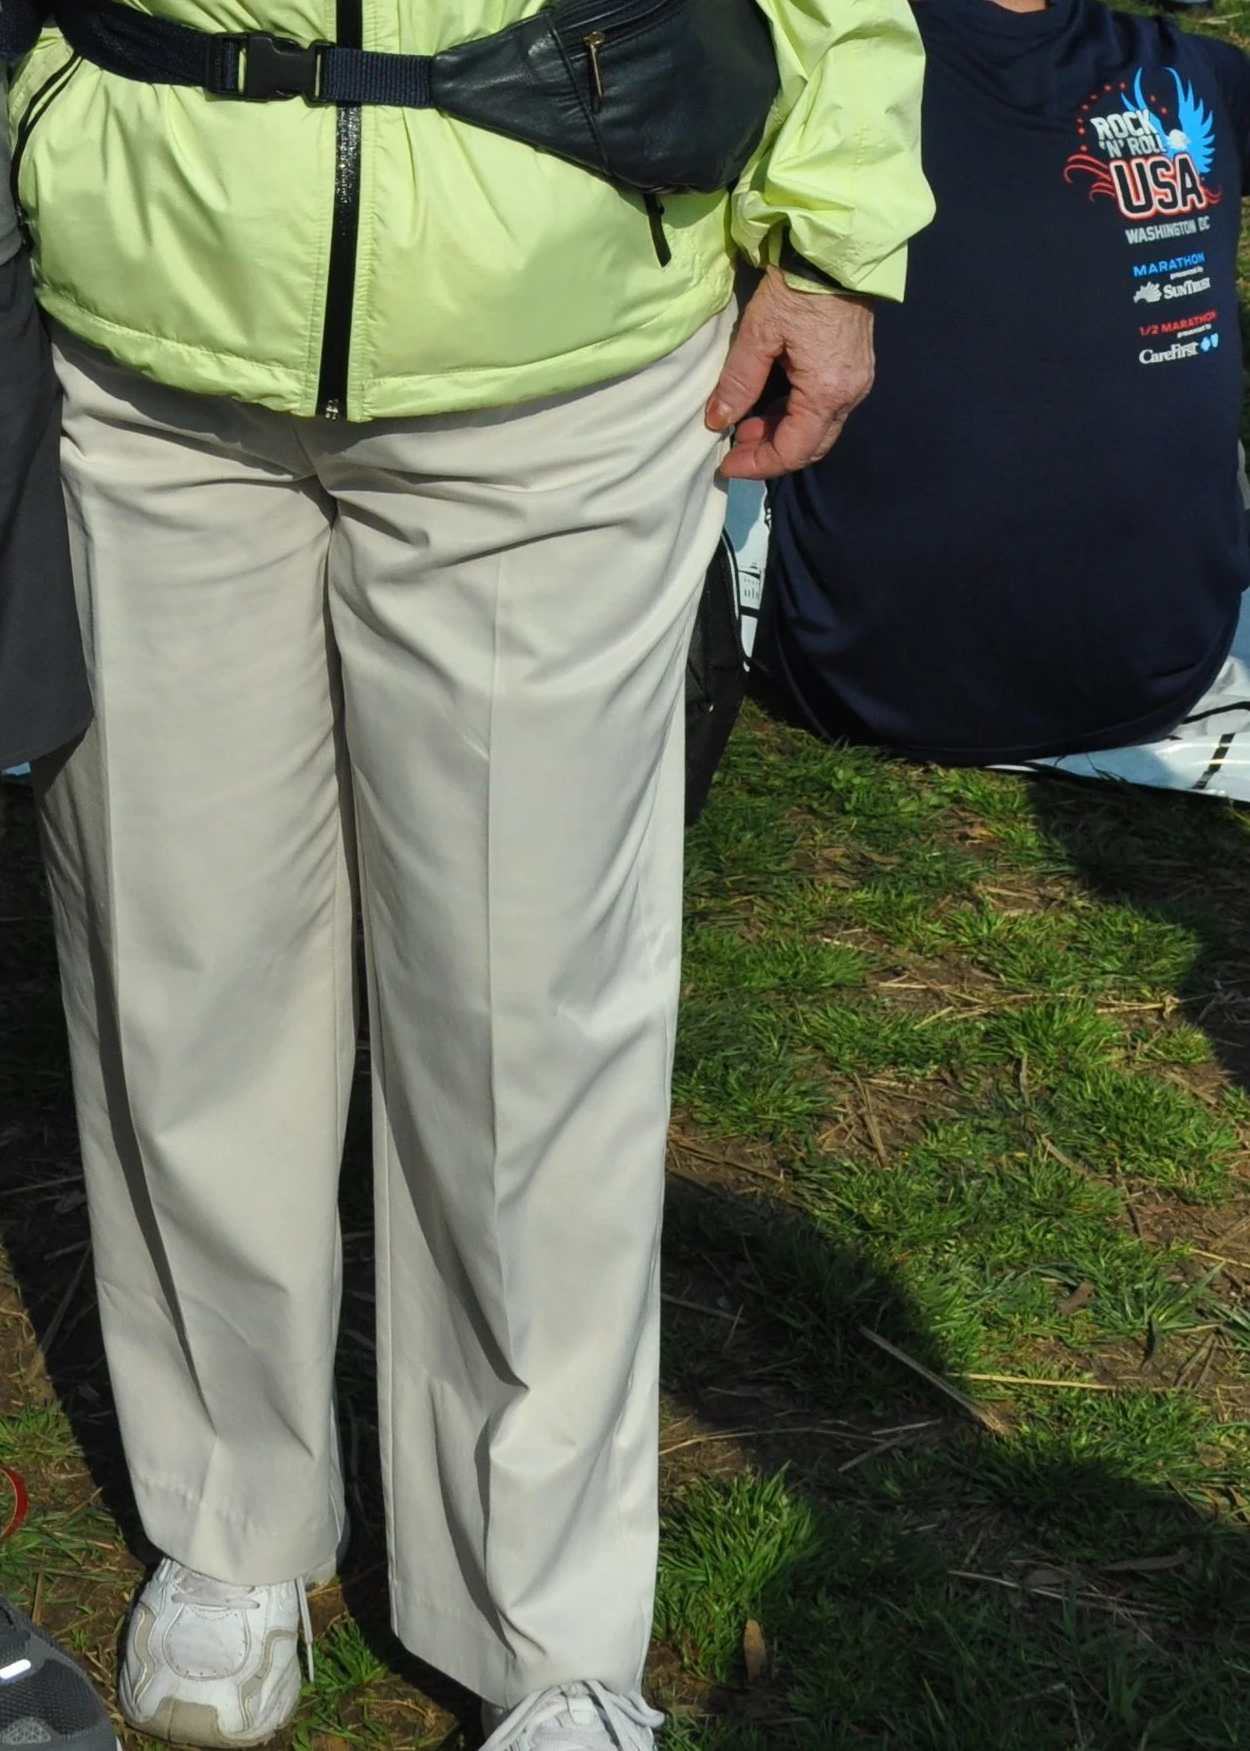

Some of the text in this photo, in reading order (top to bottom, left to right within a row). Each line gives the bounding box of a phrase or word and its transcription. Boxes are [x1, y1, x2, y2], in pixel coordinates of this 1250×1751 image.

[1090, 109, 1158, 141] ROCK
[1127, 134, 1166, 156] ROLL
[1110, 152, 1206, 219] USA
[1125, 216, 1210, 244] WASHINGTON DC
[1133, 252, 1205, 276] MARATHON
[1139, 341, 1199, 364] CareFirst
